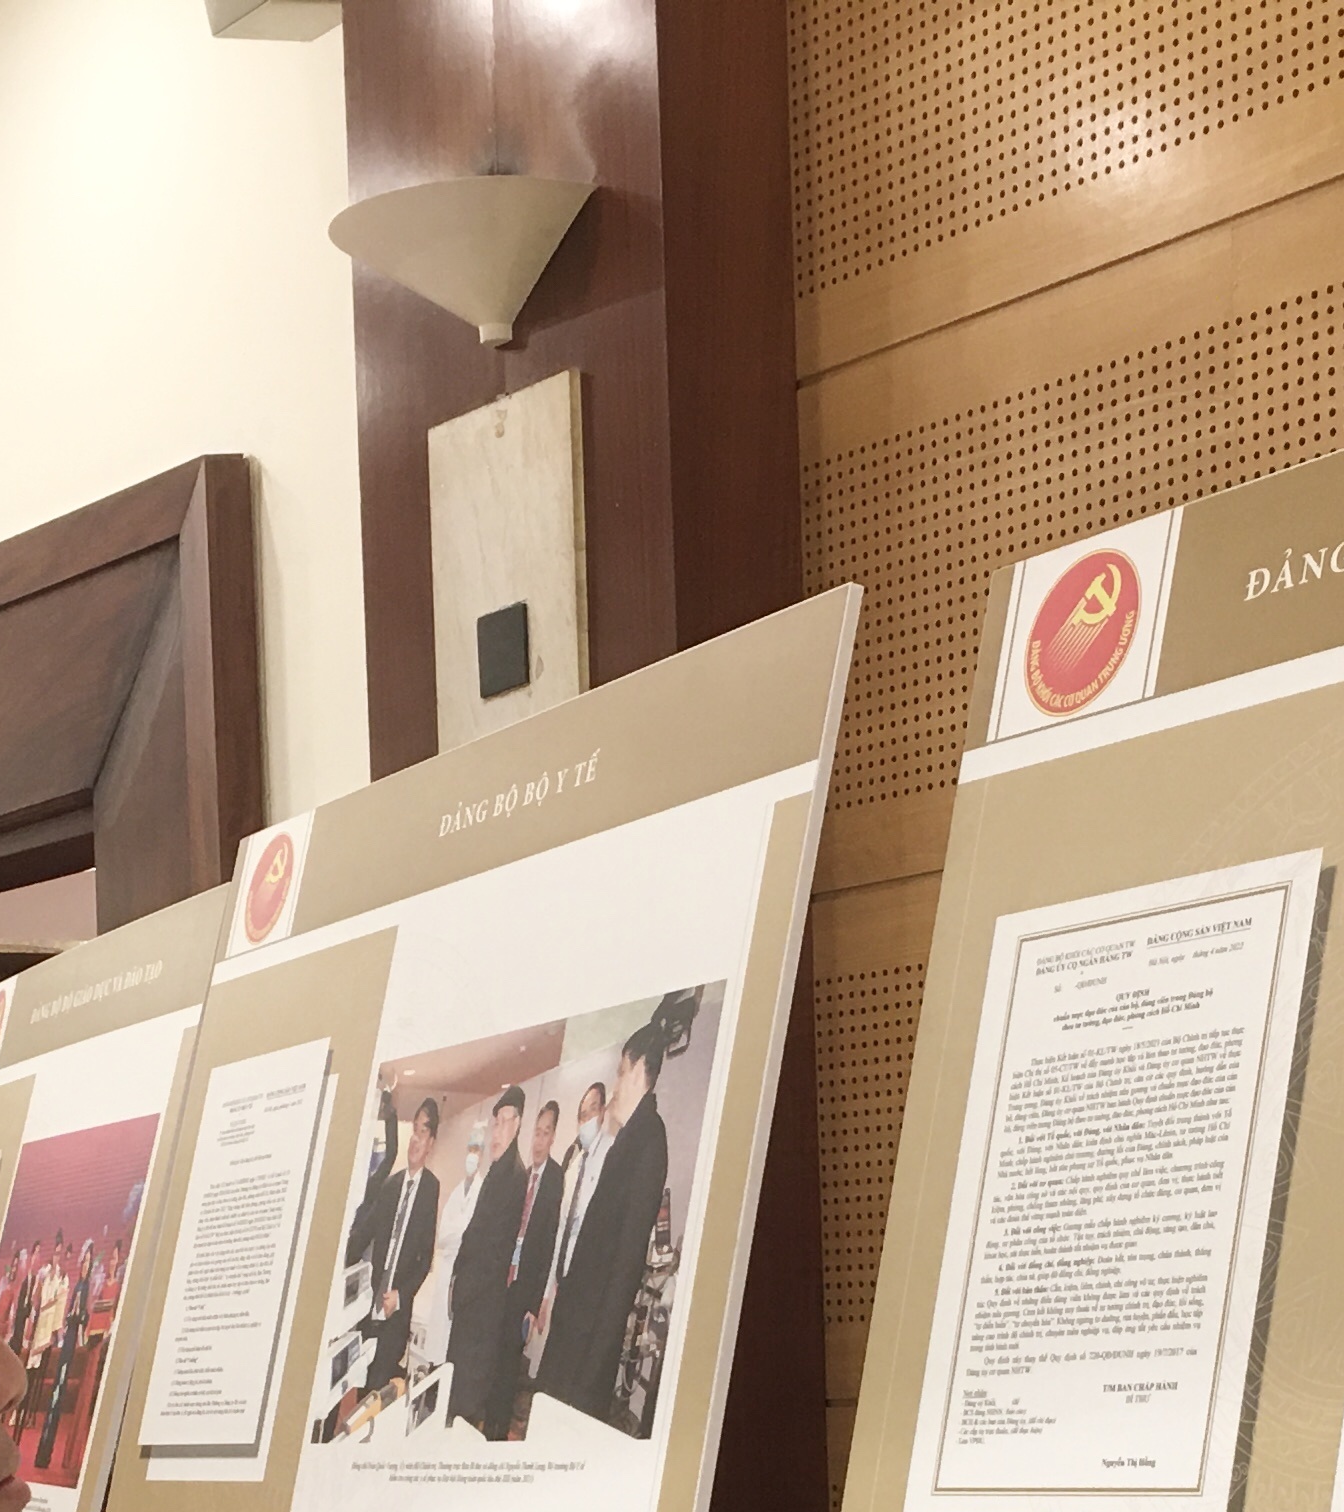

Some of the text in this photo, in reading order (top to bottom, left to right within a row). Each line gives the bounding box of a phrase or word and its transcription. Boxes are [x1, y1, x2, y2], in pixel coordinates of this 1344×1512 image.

[438, 747, 600, 838] ĐẢNG BỘ BỘ Y TẾ
